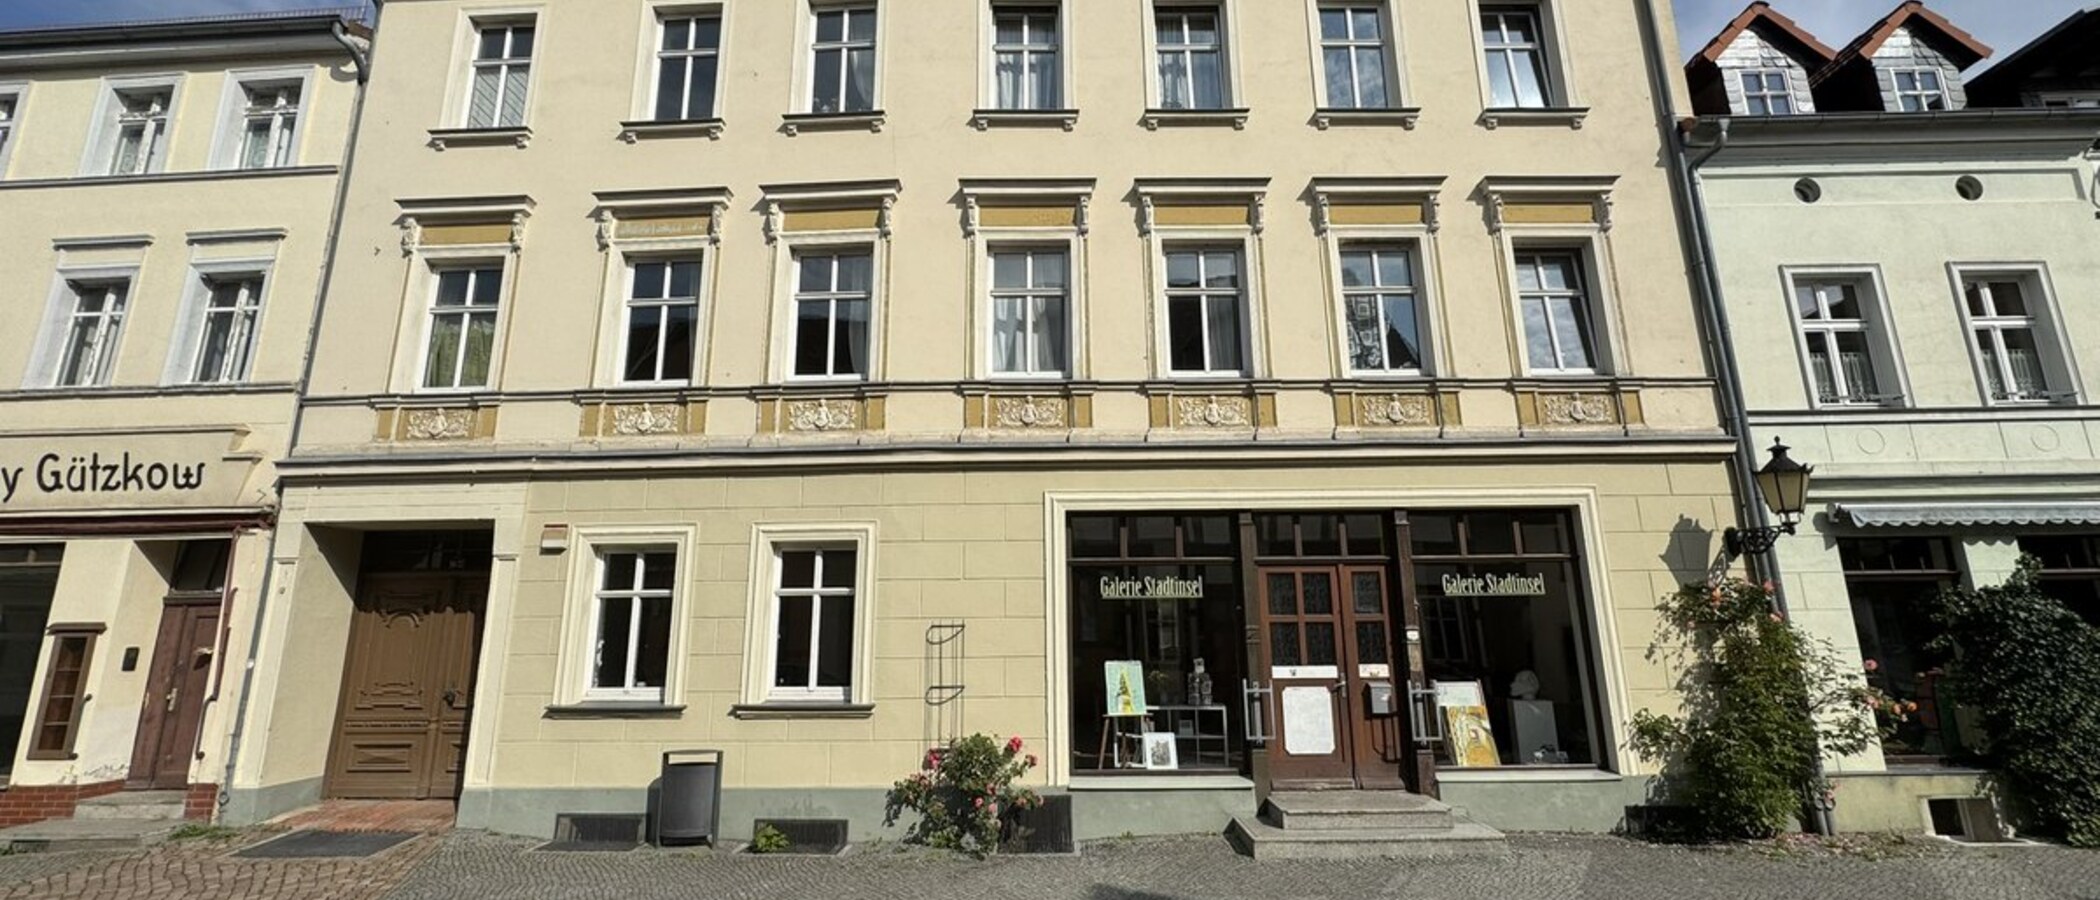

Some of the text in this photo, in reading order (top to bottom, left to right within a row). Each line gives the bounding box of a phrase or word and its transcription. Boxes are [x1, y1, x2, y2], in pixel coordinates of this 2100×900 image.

[36, 451, 206, 493] Gützkow
[1100, 575, 1203, 598] Galerie Stadtinsel
[1441, 572, 1546, 596] Galerie Stadtinsel
